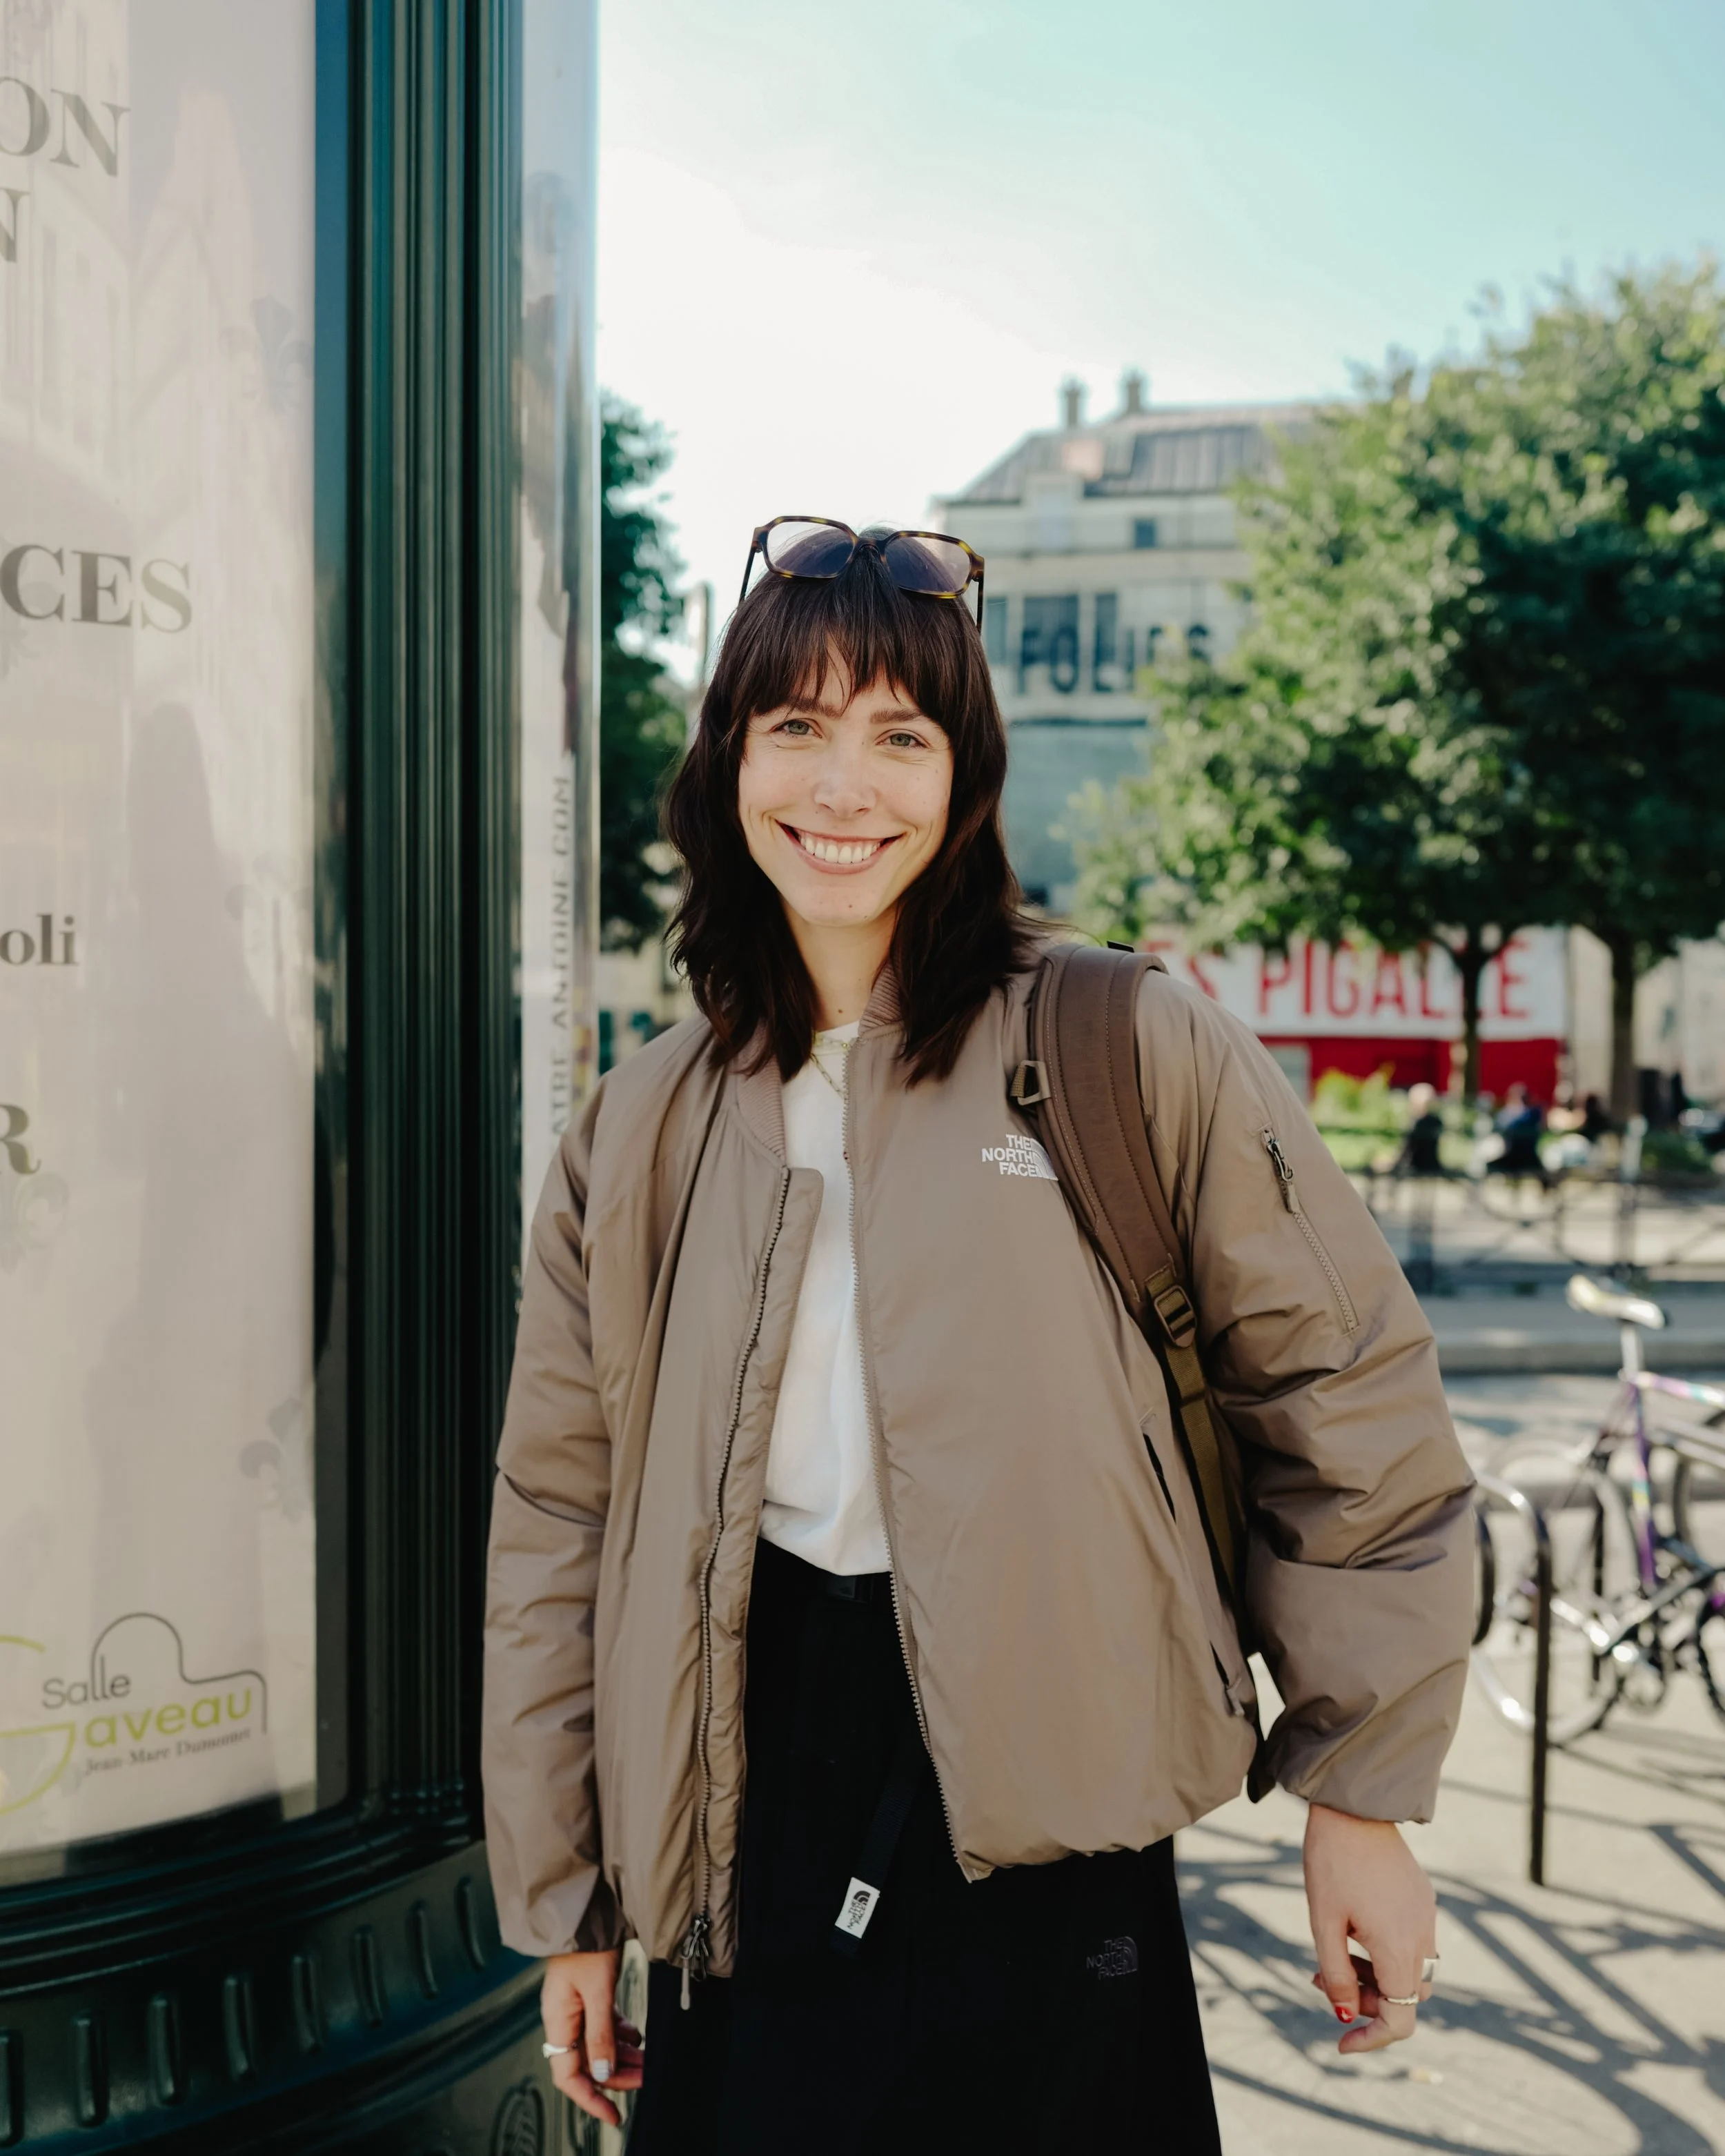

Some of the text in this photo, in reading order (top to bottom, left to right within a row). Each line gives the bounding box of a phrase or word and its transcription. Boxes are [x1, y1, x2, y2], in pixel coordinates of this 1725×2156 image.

[0, 544, 192, 633] CES
[0, 913, 79, 966] oli
[1259, 939, 1528, 1019] PIGALE
[981, 1147, 1035, 1163] NORTH
[999, 1161, 1038, 1177] FACE
[1005, 1134, 1032, 1151] THE
[42, 1654, 131, 1710] Salle
